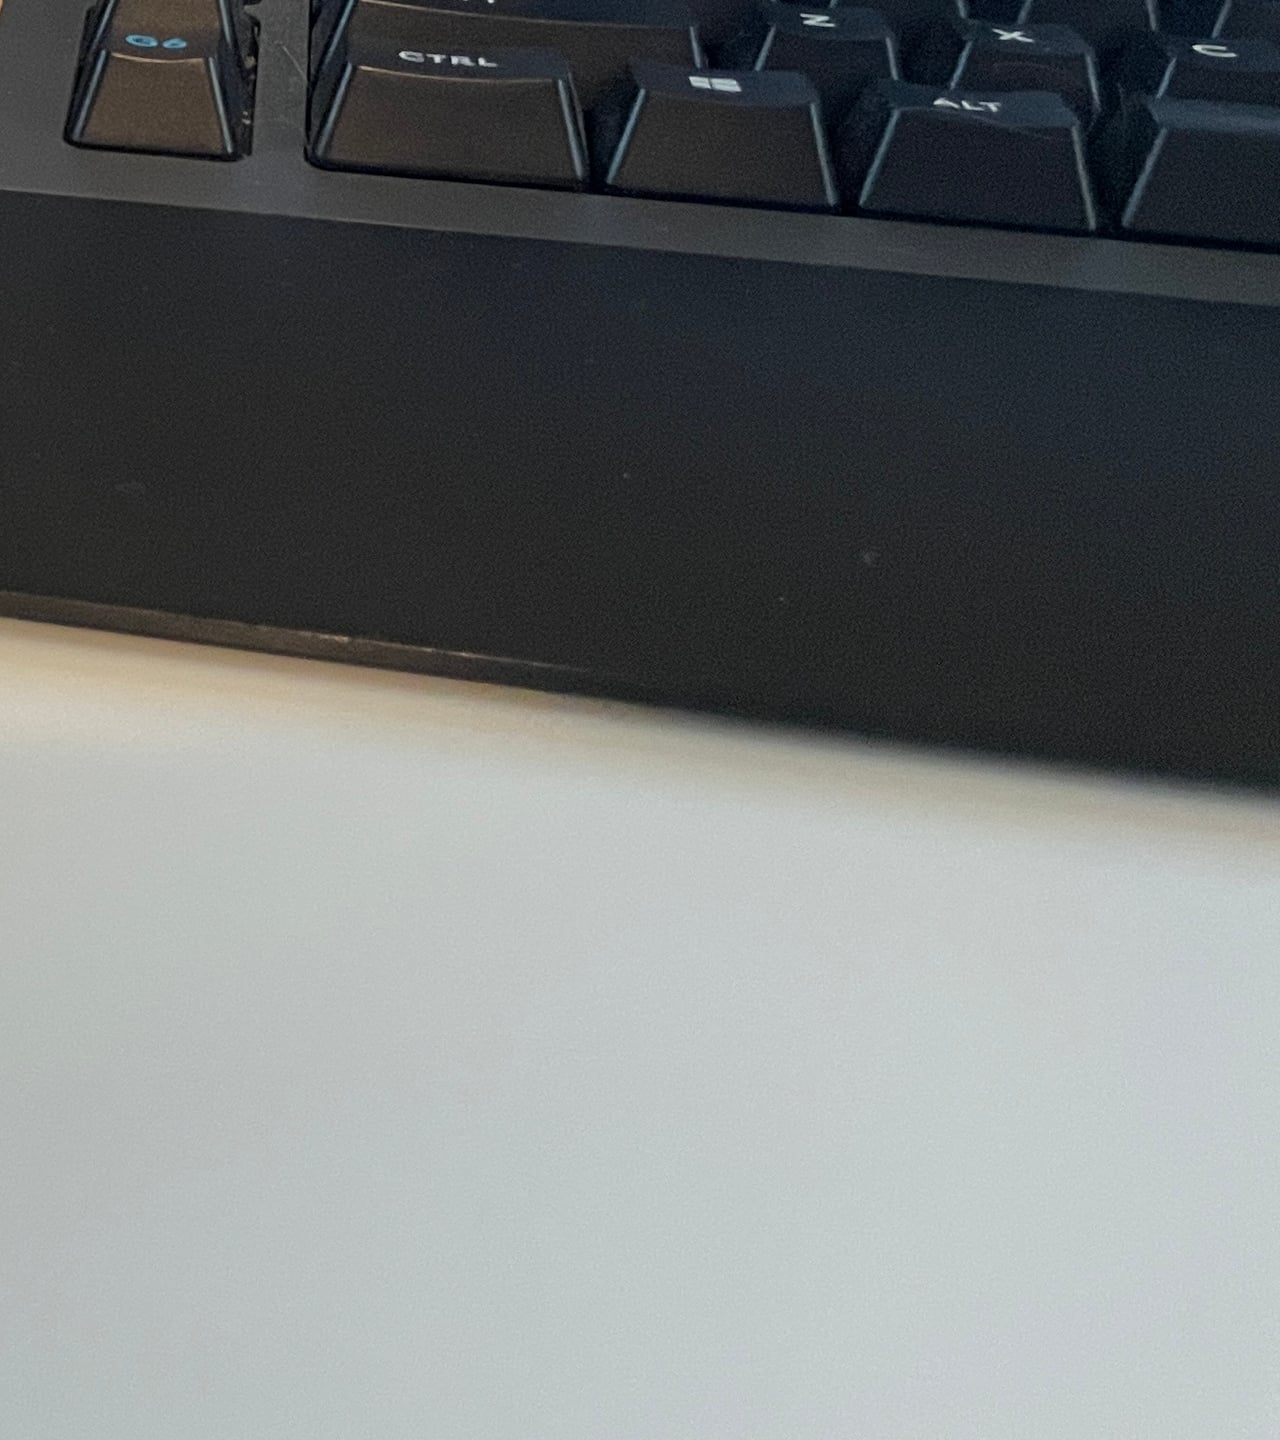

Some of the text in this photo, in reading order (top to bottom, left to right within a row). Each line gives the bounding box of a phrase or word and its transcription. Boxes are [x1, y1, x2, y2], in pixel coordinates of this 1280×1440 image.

[799, 12, 836, 27] Z
[125, 34, 188, 50] G6
[991, 27, 1034, 43] X
[398, 50, 499, 68] CTRL
[1191, 44, 1238, 58] C
[933, 97, 1001, 113] ALT
